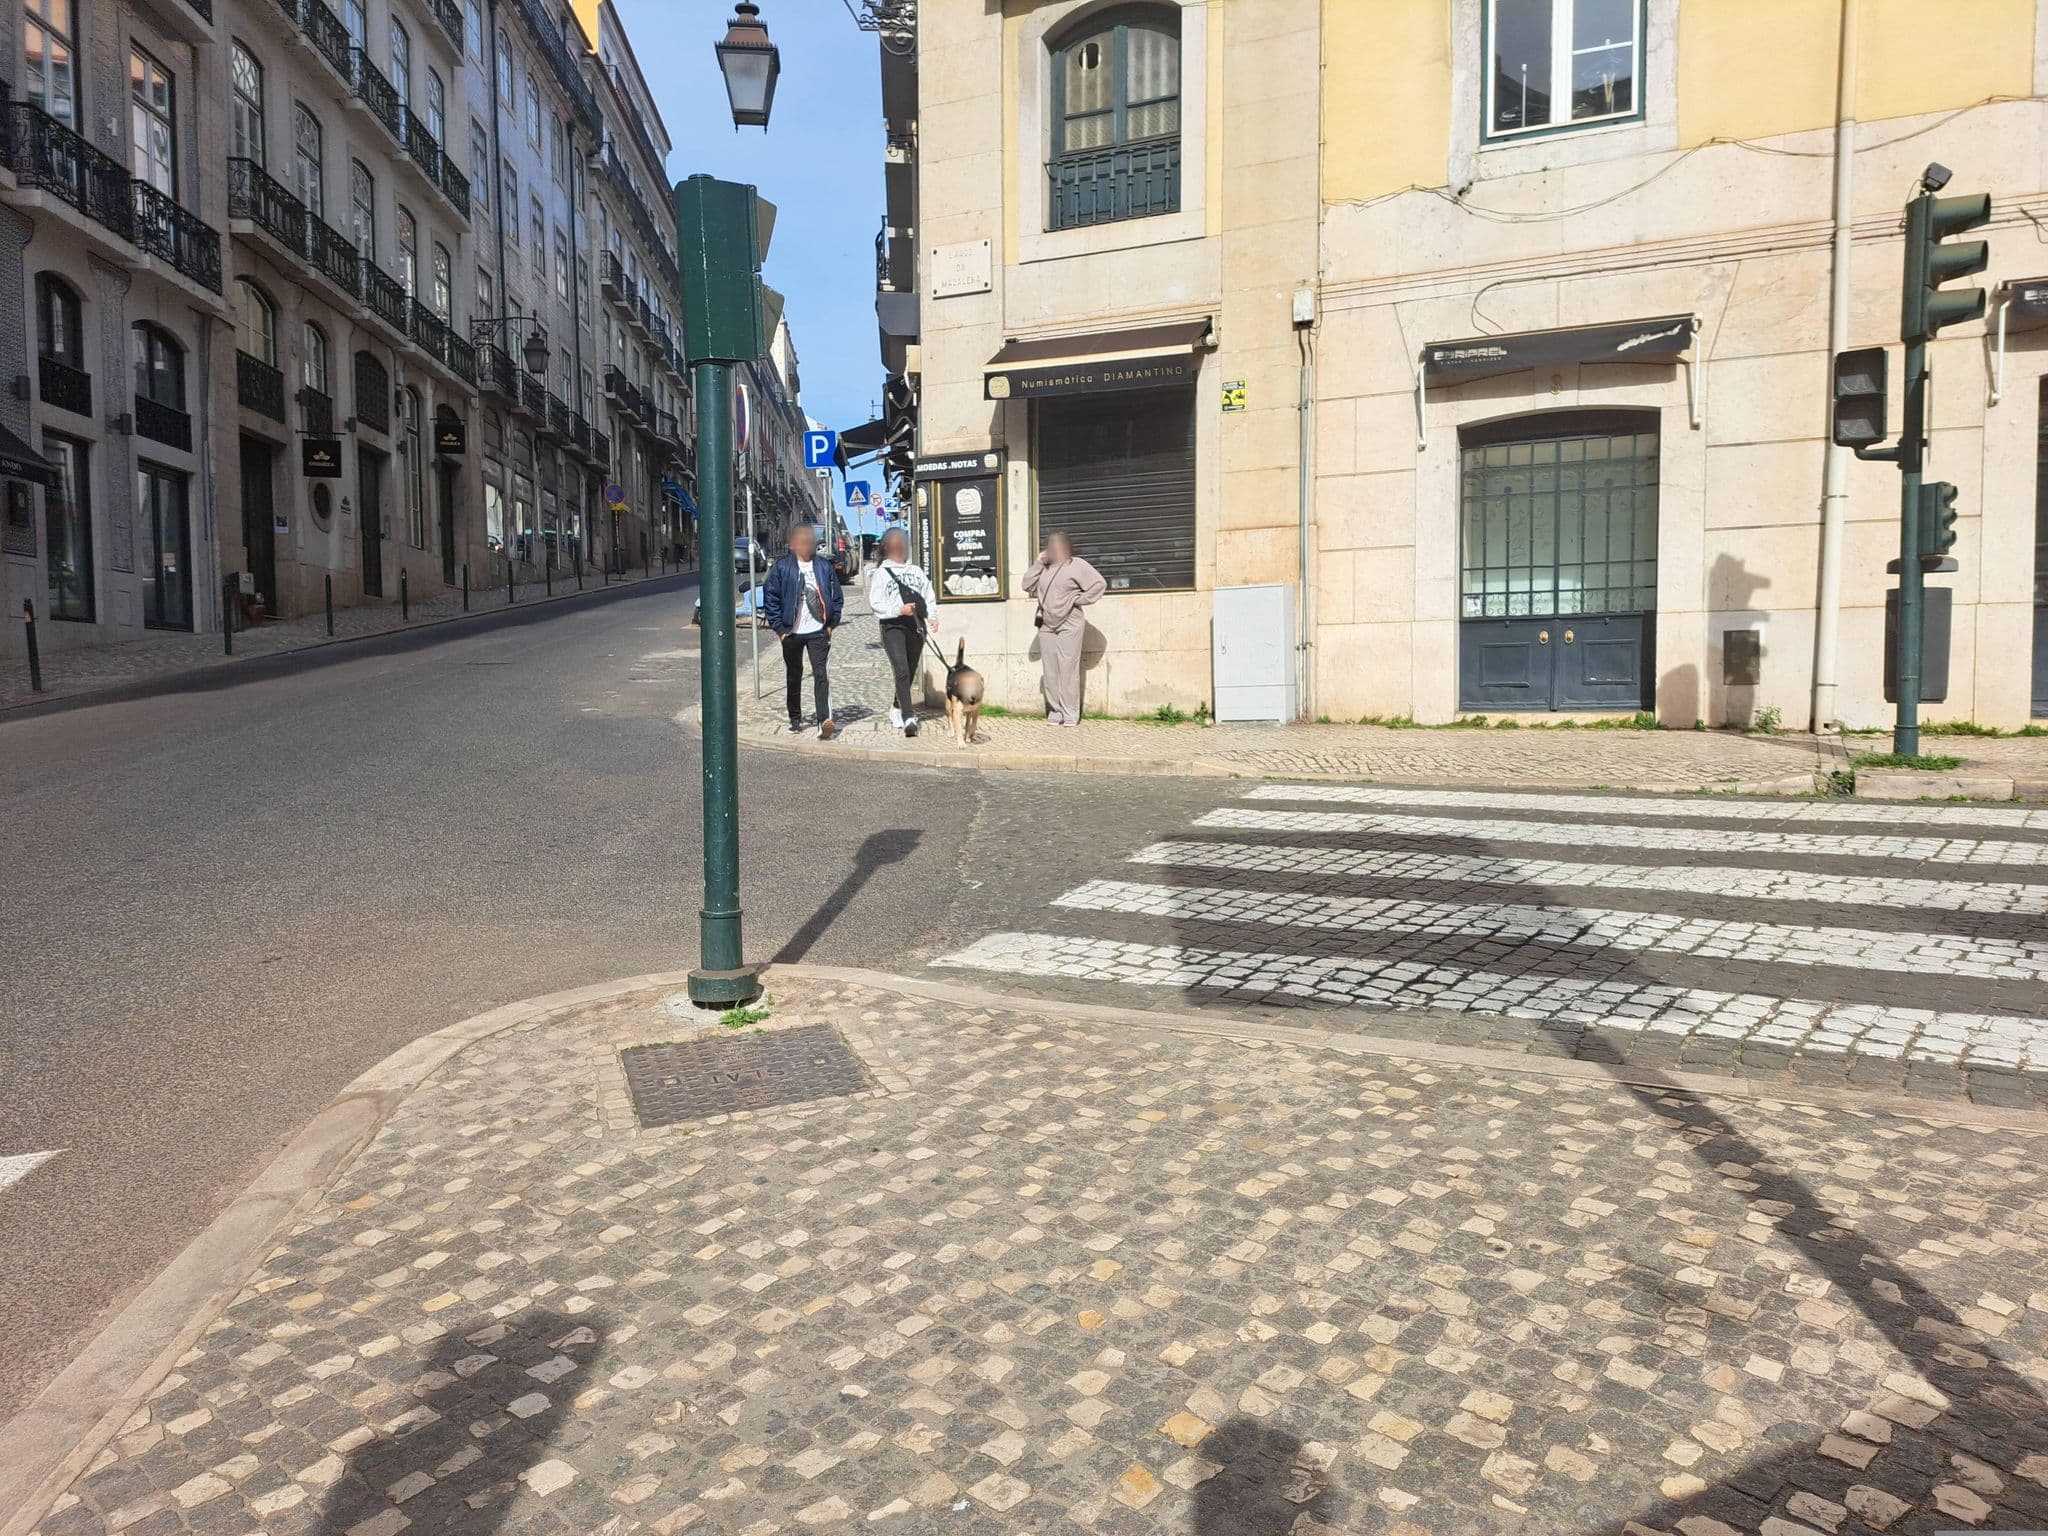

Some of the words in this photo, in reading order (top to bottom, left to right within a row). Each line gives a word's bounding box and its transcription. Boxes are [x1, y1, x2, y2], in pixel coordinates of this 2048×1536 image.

[956, 263, 966, 272] DA
[1021, 375, 1093, 389] Numismática
[1103, 366, 1183, 382] DIAMANTINO
[812, 434, 829, 463] P
[922, 518, 930, 548] MOEDAS
[953, 529, 986, 538] COMPRA
[956, 542, 983, 550] VENDA
